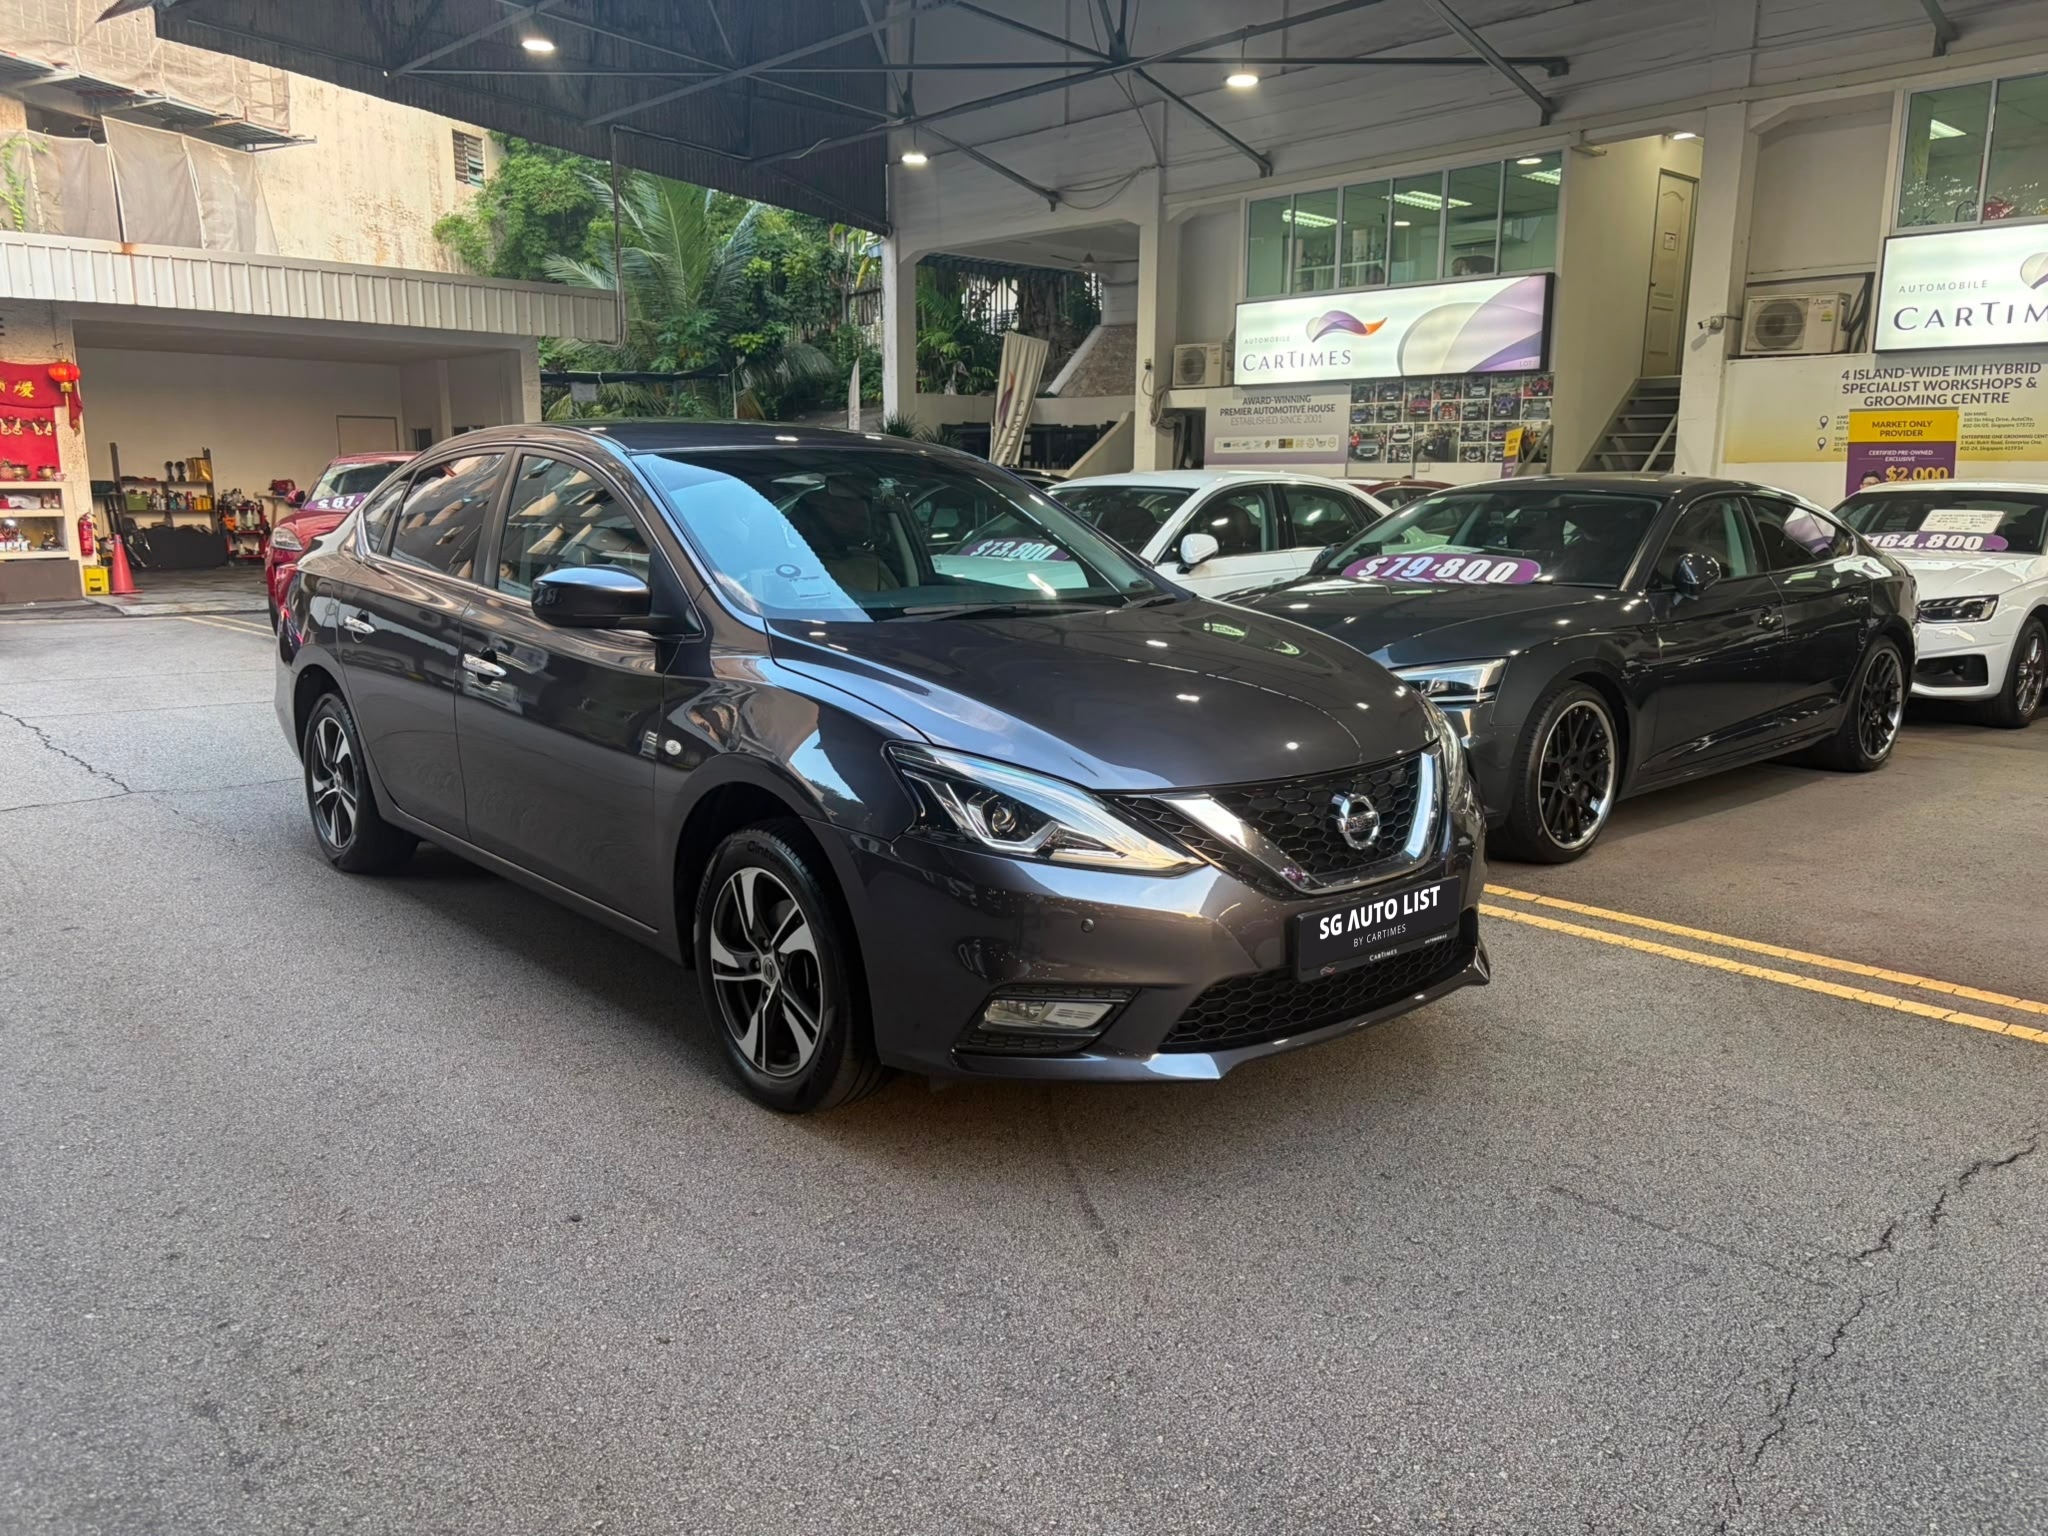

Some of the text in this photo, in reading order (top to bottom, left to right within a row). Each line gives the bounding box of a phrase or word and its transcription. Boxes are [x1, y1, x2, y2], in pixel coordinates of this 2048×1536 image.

[1898, 279, 1989, 294] AUTOMOBILE
[1243, 336, 1291, 345] AUTOMOBILE
[1242, 349, 1352, 372] CARTIMES
[1841, 362, 2042, 380] 4 ISLAND-WIDE IMI HYBRID
[1842, 377, 2038, 394] SPECIALIST WORKSHOPS &
[1242, 395, 1312, 405] AWARD-WINNING
[1863, 392, 2010, 407] GROOMING CENTRE
[1220, 404, 1336, 416] PREMIER AUTOMOTIVE HOUSE
[1230, 414, 1322, 426] ESTABLISHED SINCE 2001
[1871, 420, 1933, 429] MARKET ONLY
[1879, 429, 1924, 437] PROVIDER
[1369, 948, 1398, 962] CARTIMES
